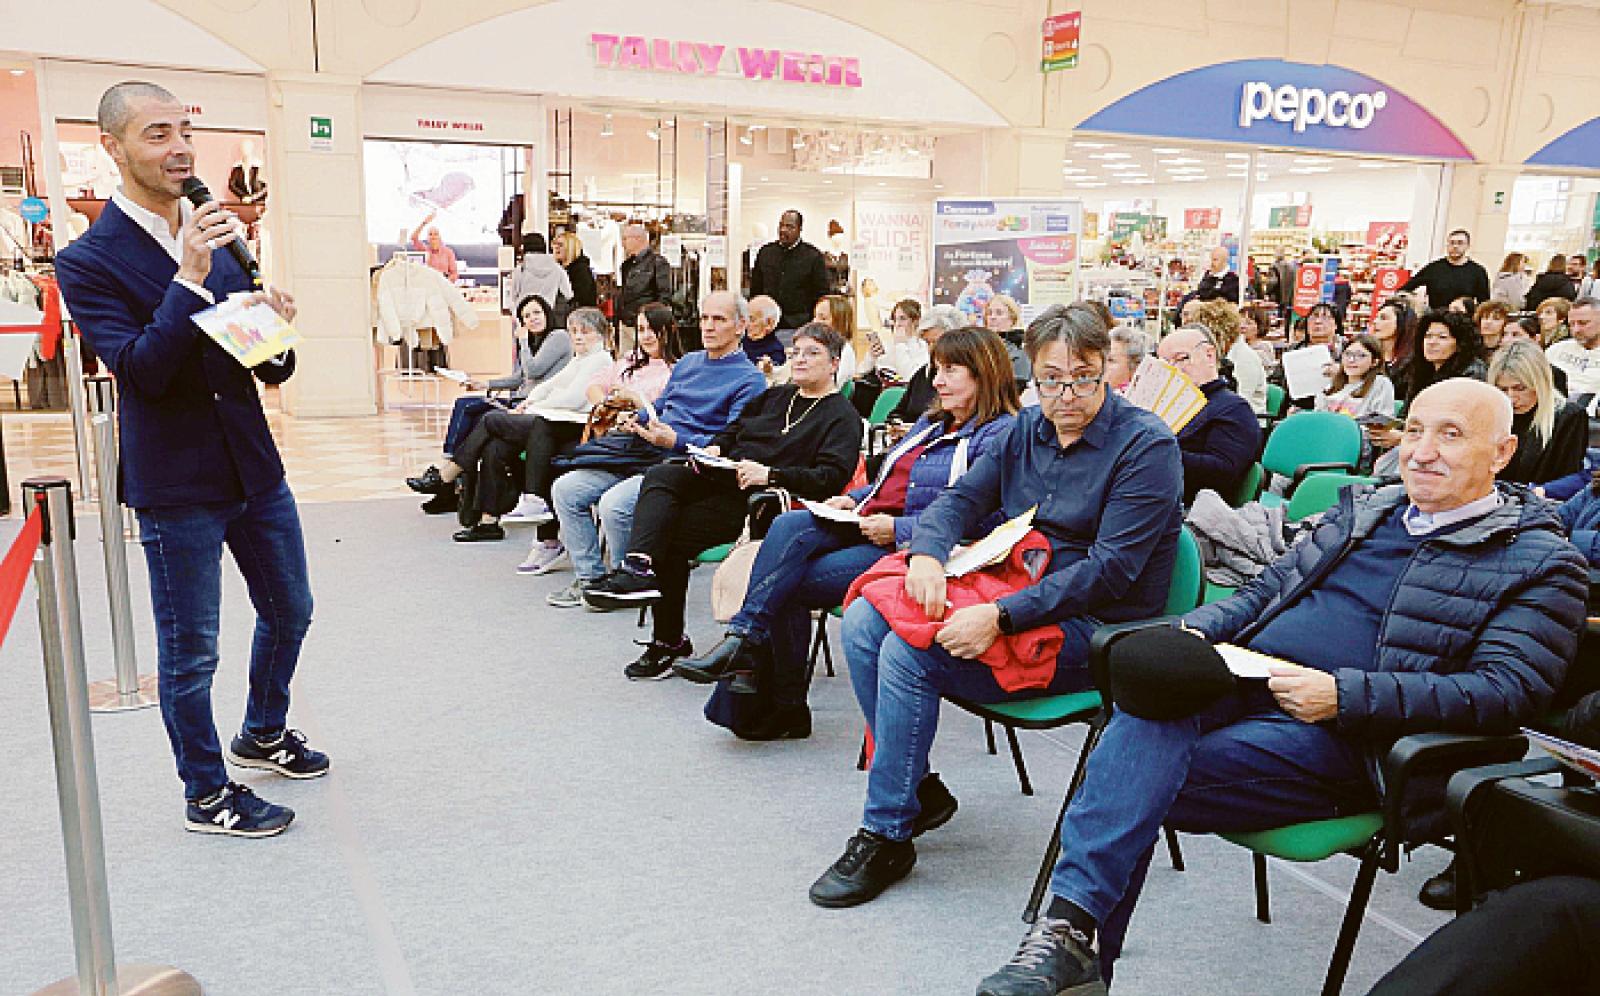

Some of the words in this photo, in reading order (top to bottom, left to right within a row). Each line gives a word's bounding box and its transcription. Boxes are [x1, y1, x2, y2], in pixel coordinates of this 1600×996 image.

[591, 33, 725, 75] TALLY
[1239, 81, 1376, 133] pepco
[860, 212, 922, 227] WANNA
[861, 229, 921, 248] SLIDE
[268, 749, 296, 765] N
[212, 808, 241, 829] N
